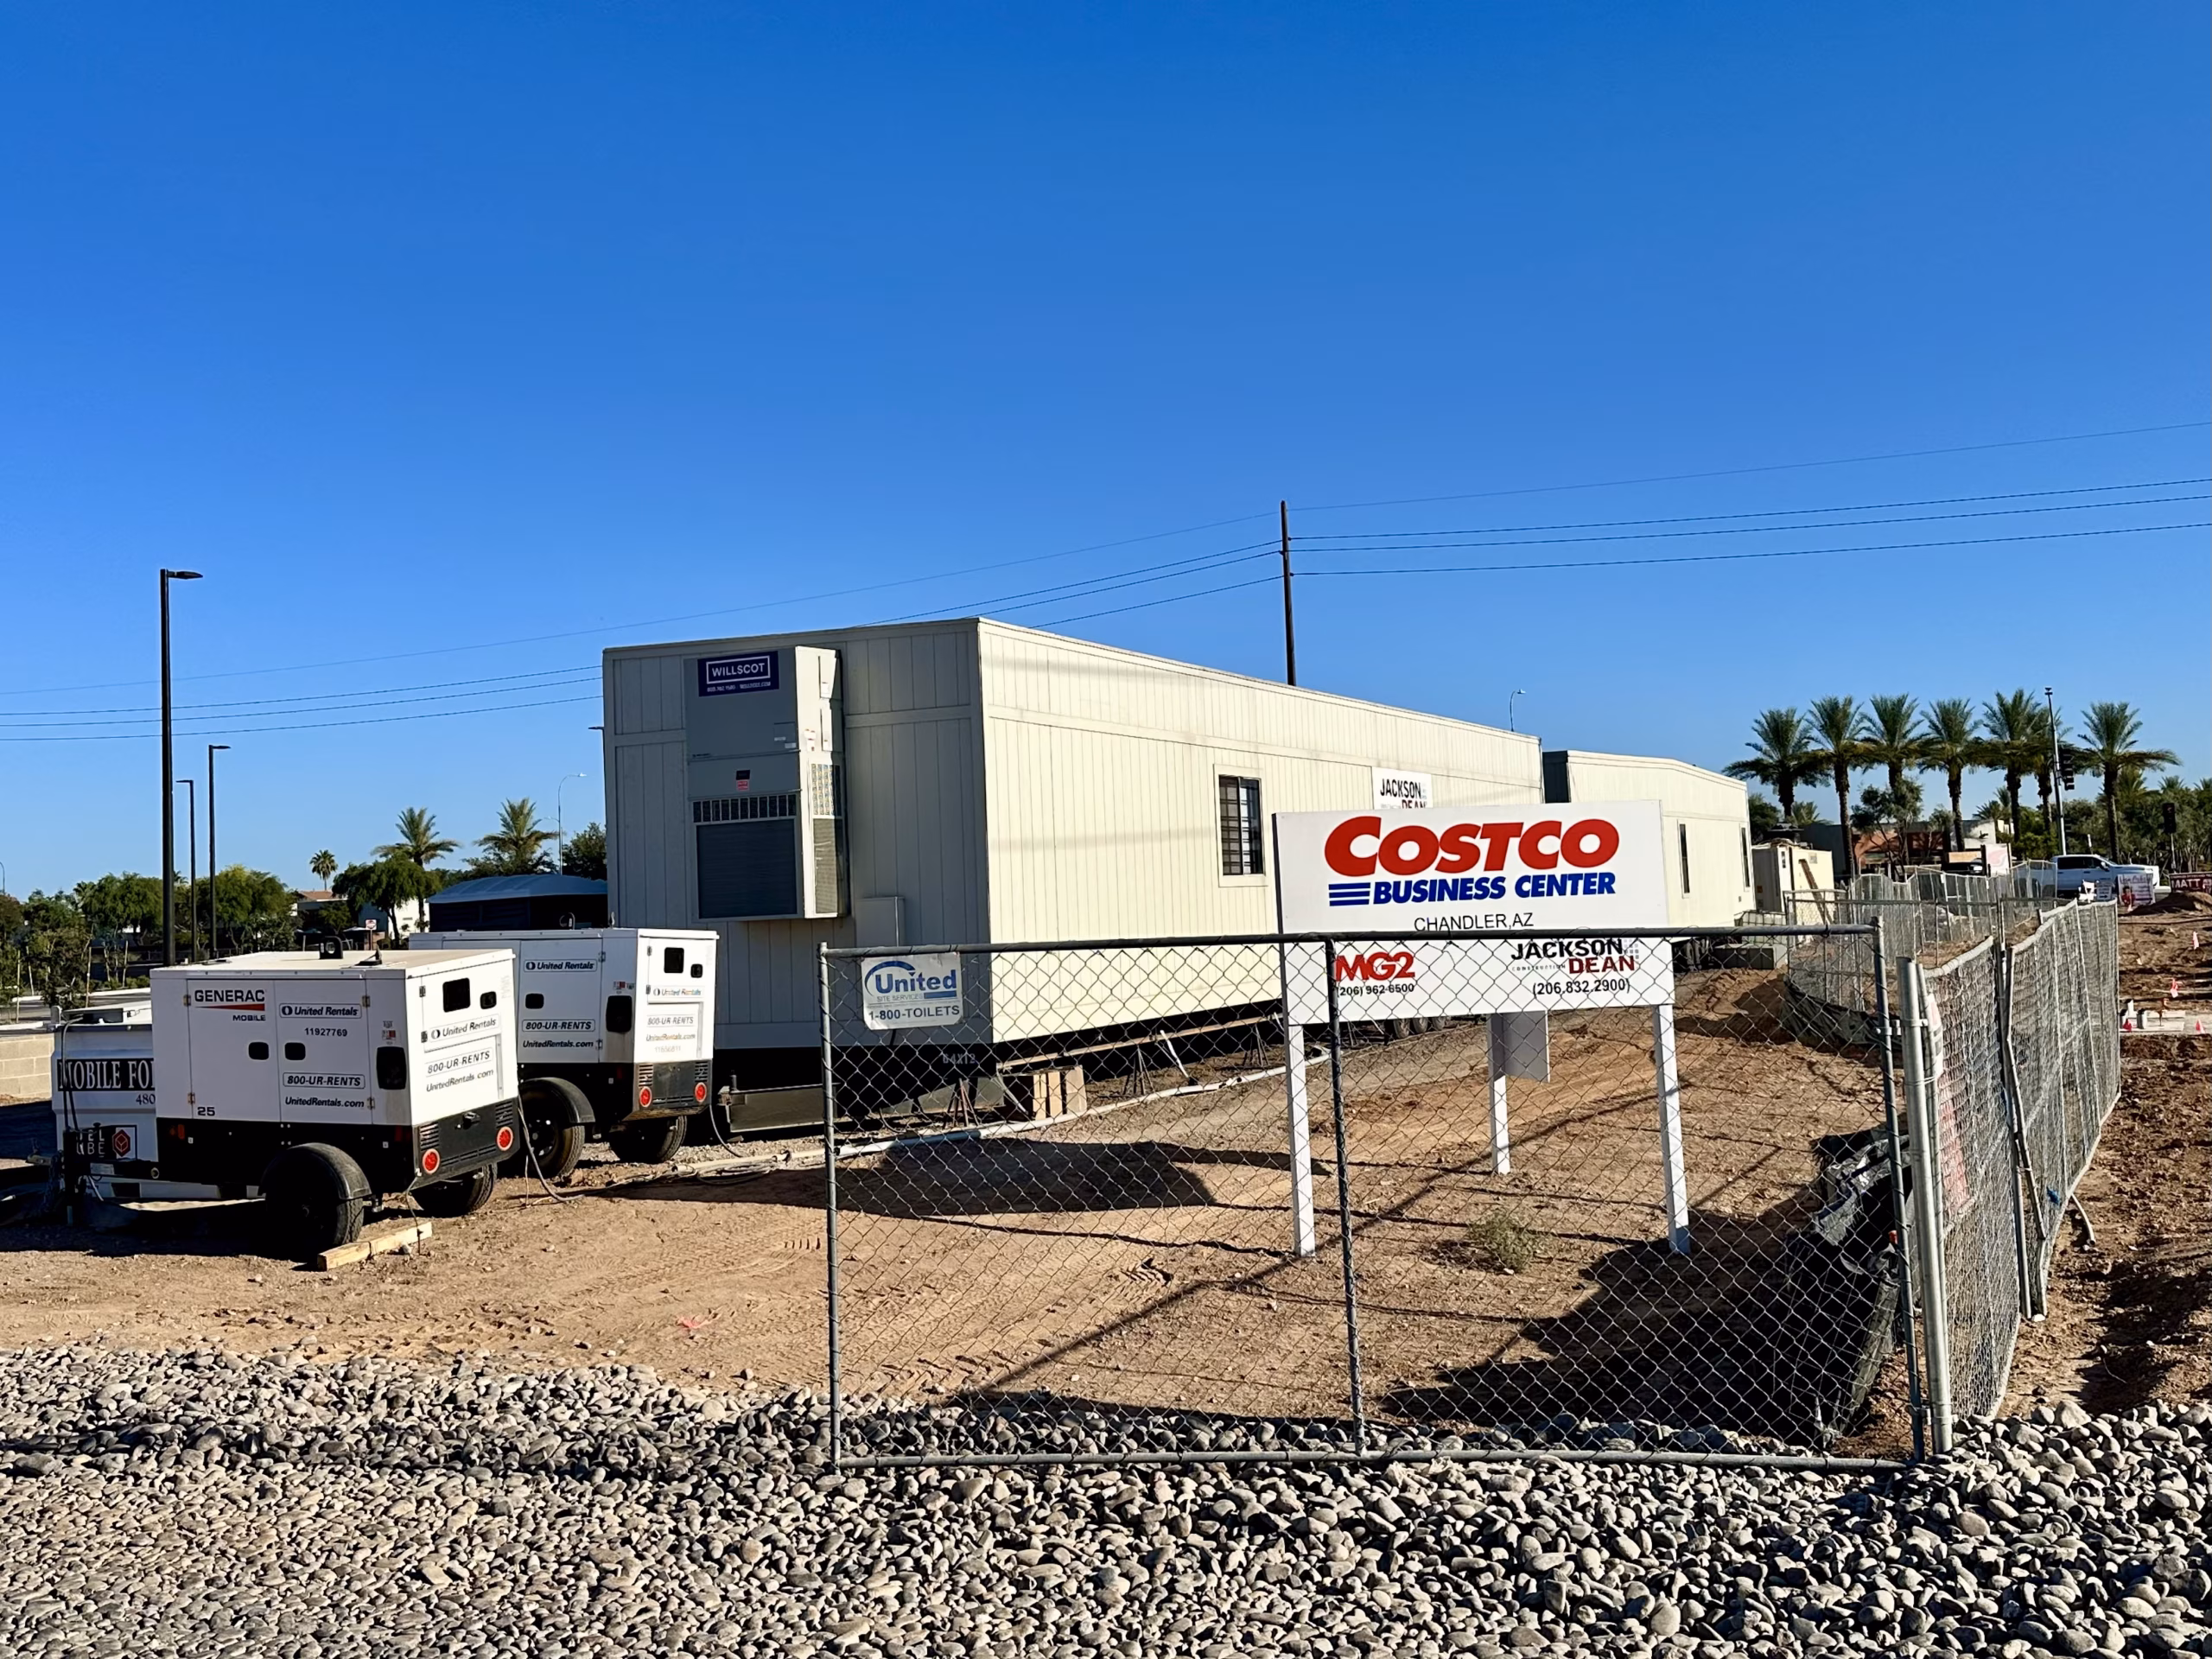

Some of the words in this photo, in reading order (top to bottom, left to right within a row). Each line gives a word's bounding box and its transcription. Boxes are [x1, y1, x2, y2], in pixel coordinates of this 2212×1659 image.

[712, 663, 765, 677] WILLSCOT
[1380, 779, 1421, 799] JACKSON
[1325, 816, 1619, 877] COSTCO
[1373, 876, 1506, 905] BUSINESS
[1515, 872, 1616, 899] CENTER
[1511, 938, 1622, 960] JACKSON
[1335, 951, 1415, 982] MG2
[1568, 956, 1635, 974] DEAN
[875, 969, 957, 994] United
[194, 989, 265, 1002] GENERAC
[295, 1007, 323, 1015] United
[325, 1007, 359, 1016] Rentals
[868, 1005, 960, 1020] 1-800-TOILETS
[304, 1027, 347, 1037] 11927769
[442, 1023, 467, 1037] United
[469, 1018, 496, 1031] Rentals
[525, 1021, 592, 1030] 800-UR-RENTS
[127, 1060, 156, 1089] FO
[287, 1076, 360, 1086] 800-UR-RENTS
[285, 1096, 364, 1107] UnitedRentals.com
[197, 1107, 215, 1116] 25
